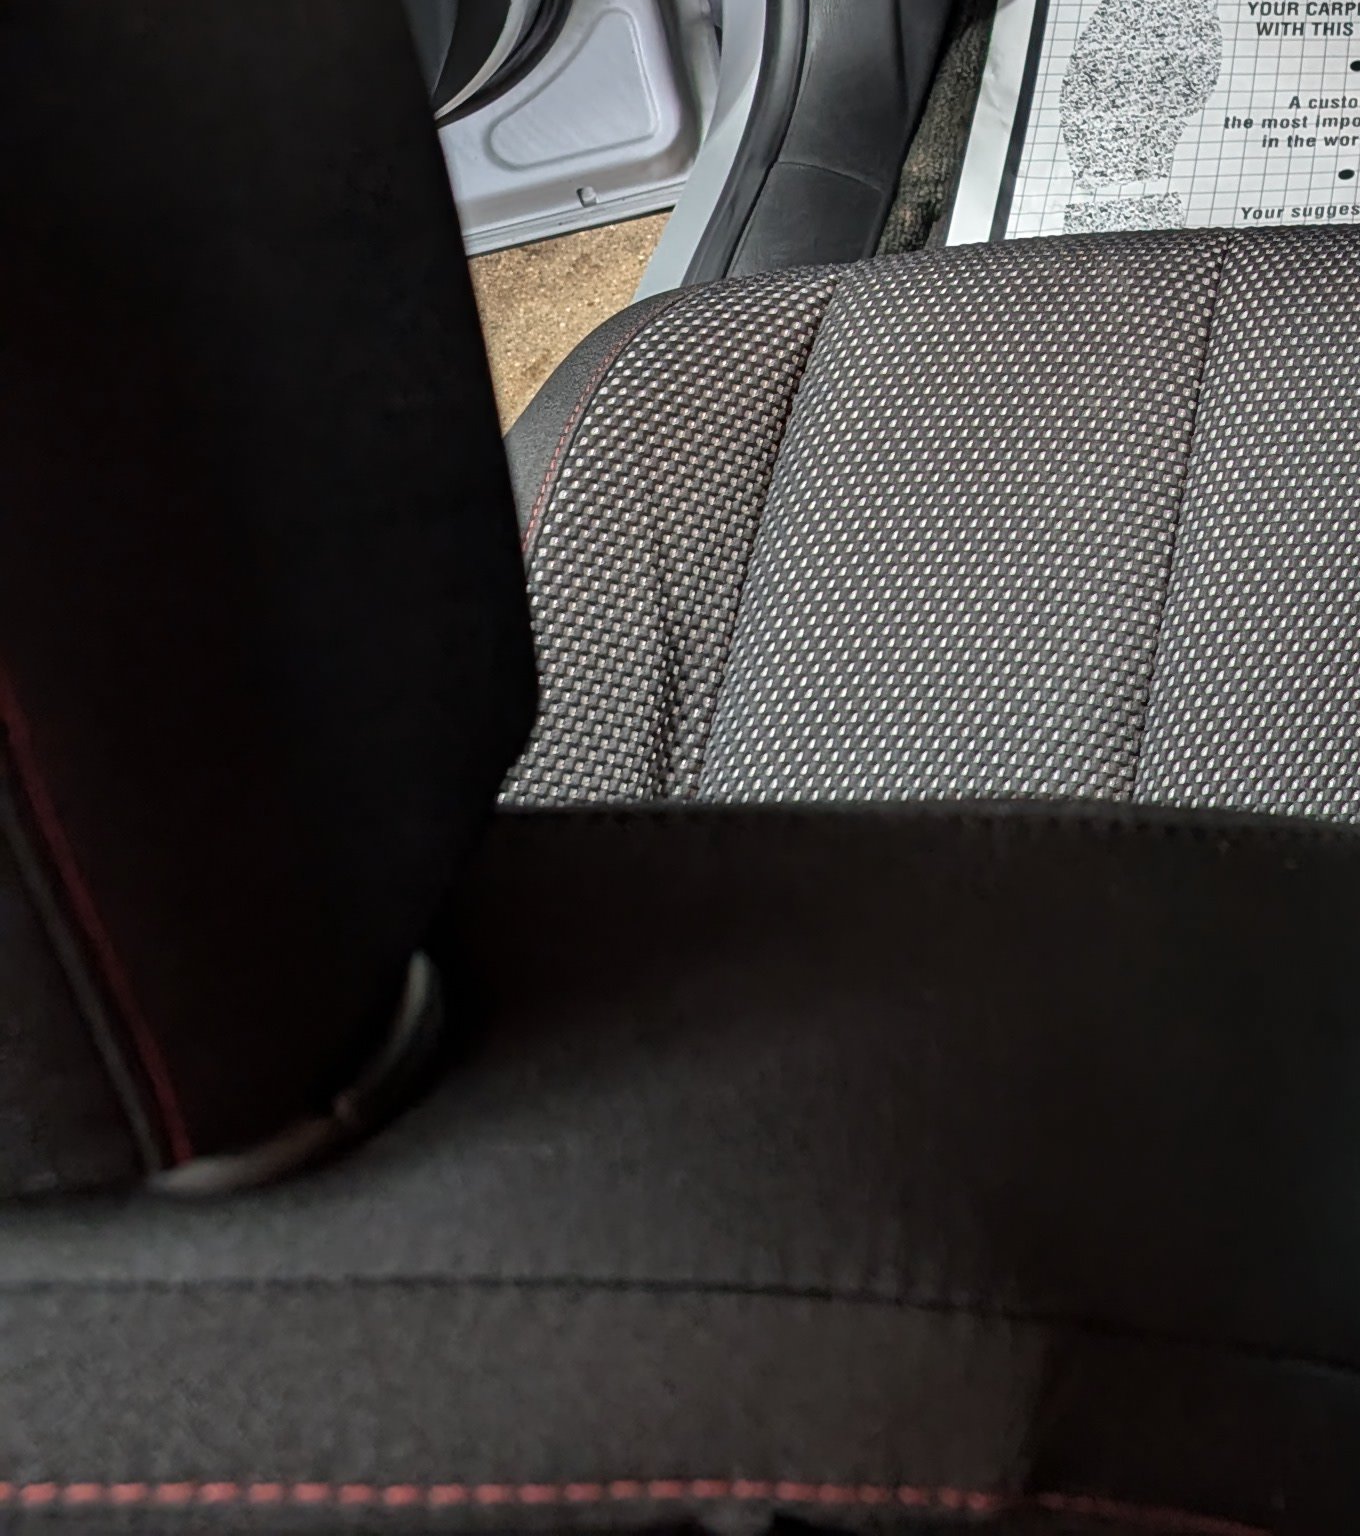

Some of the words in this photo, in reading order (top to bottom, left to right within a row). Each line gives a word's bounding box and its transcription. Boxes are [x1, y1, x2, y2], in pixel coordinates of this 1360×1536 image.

[1248, 1, 1299, 16] YOUR
[1256, 22, 1304, 37] WITH
[1312, 22, 1354, 37] THIS
[1288, 95, 1301, 109] A
[1224, 115, 1253, 129] the
[1261, 115, 1308, 129] most
[1262, 134, 1279, 148] in
[1287, 134, 1317, 148] the
[1241, 206, 1285, 220] Your
